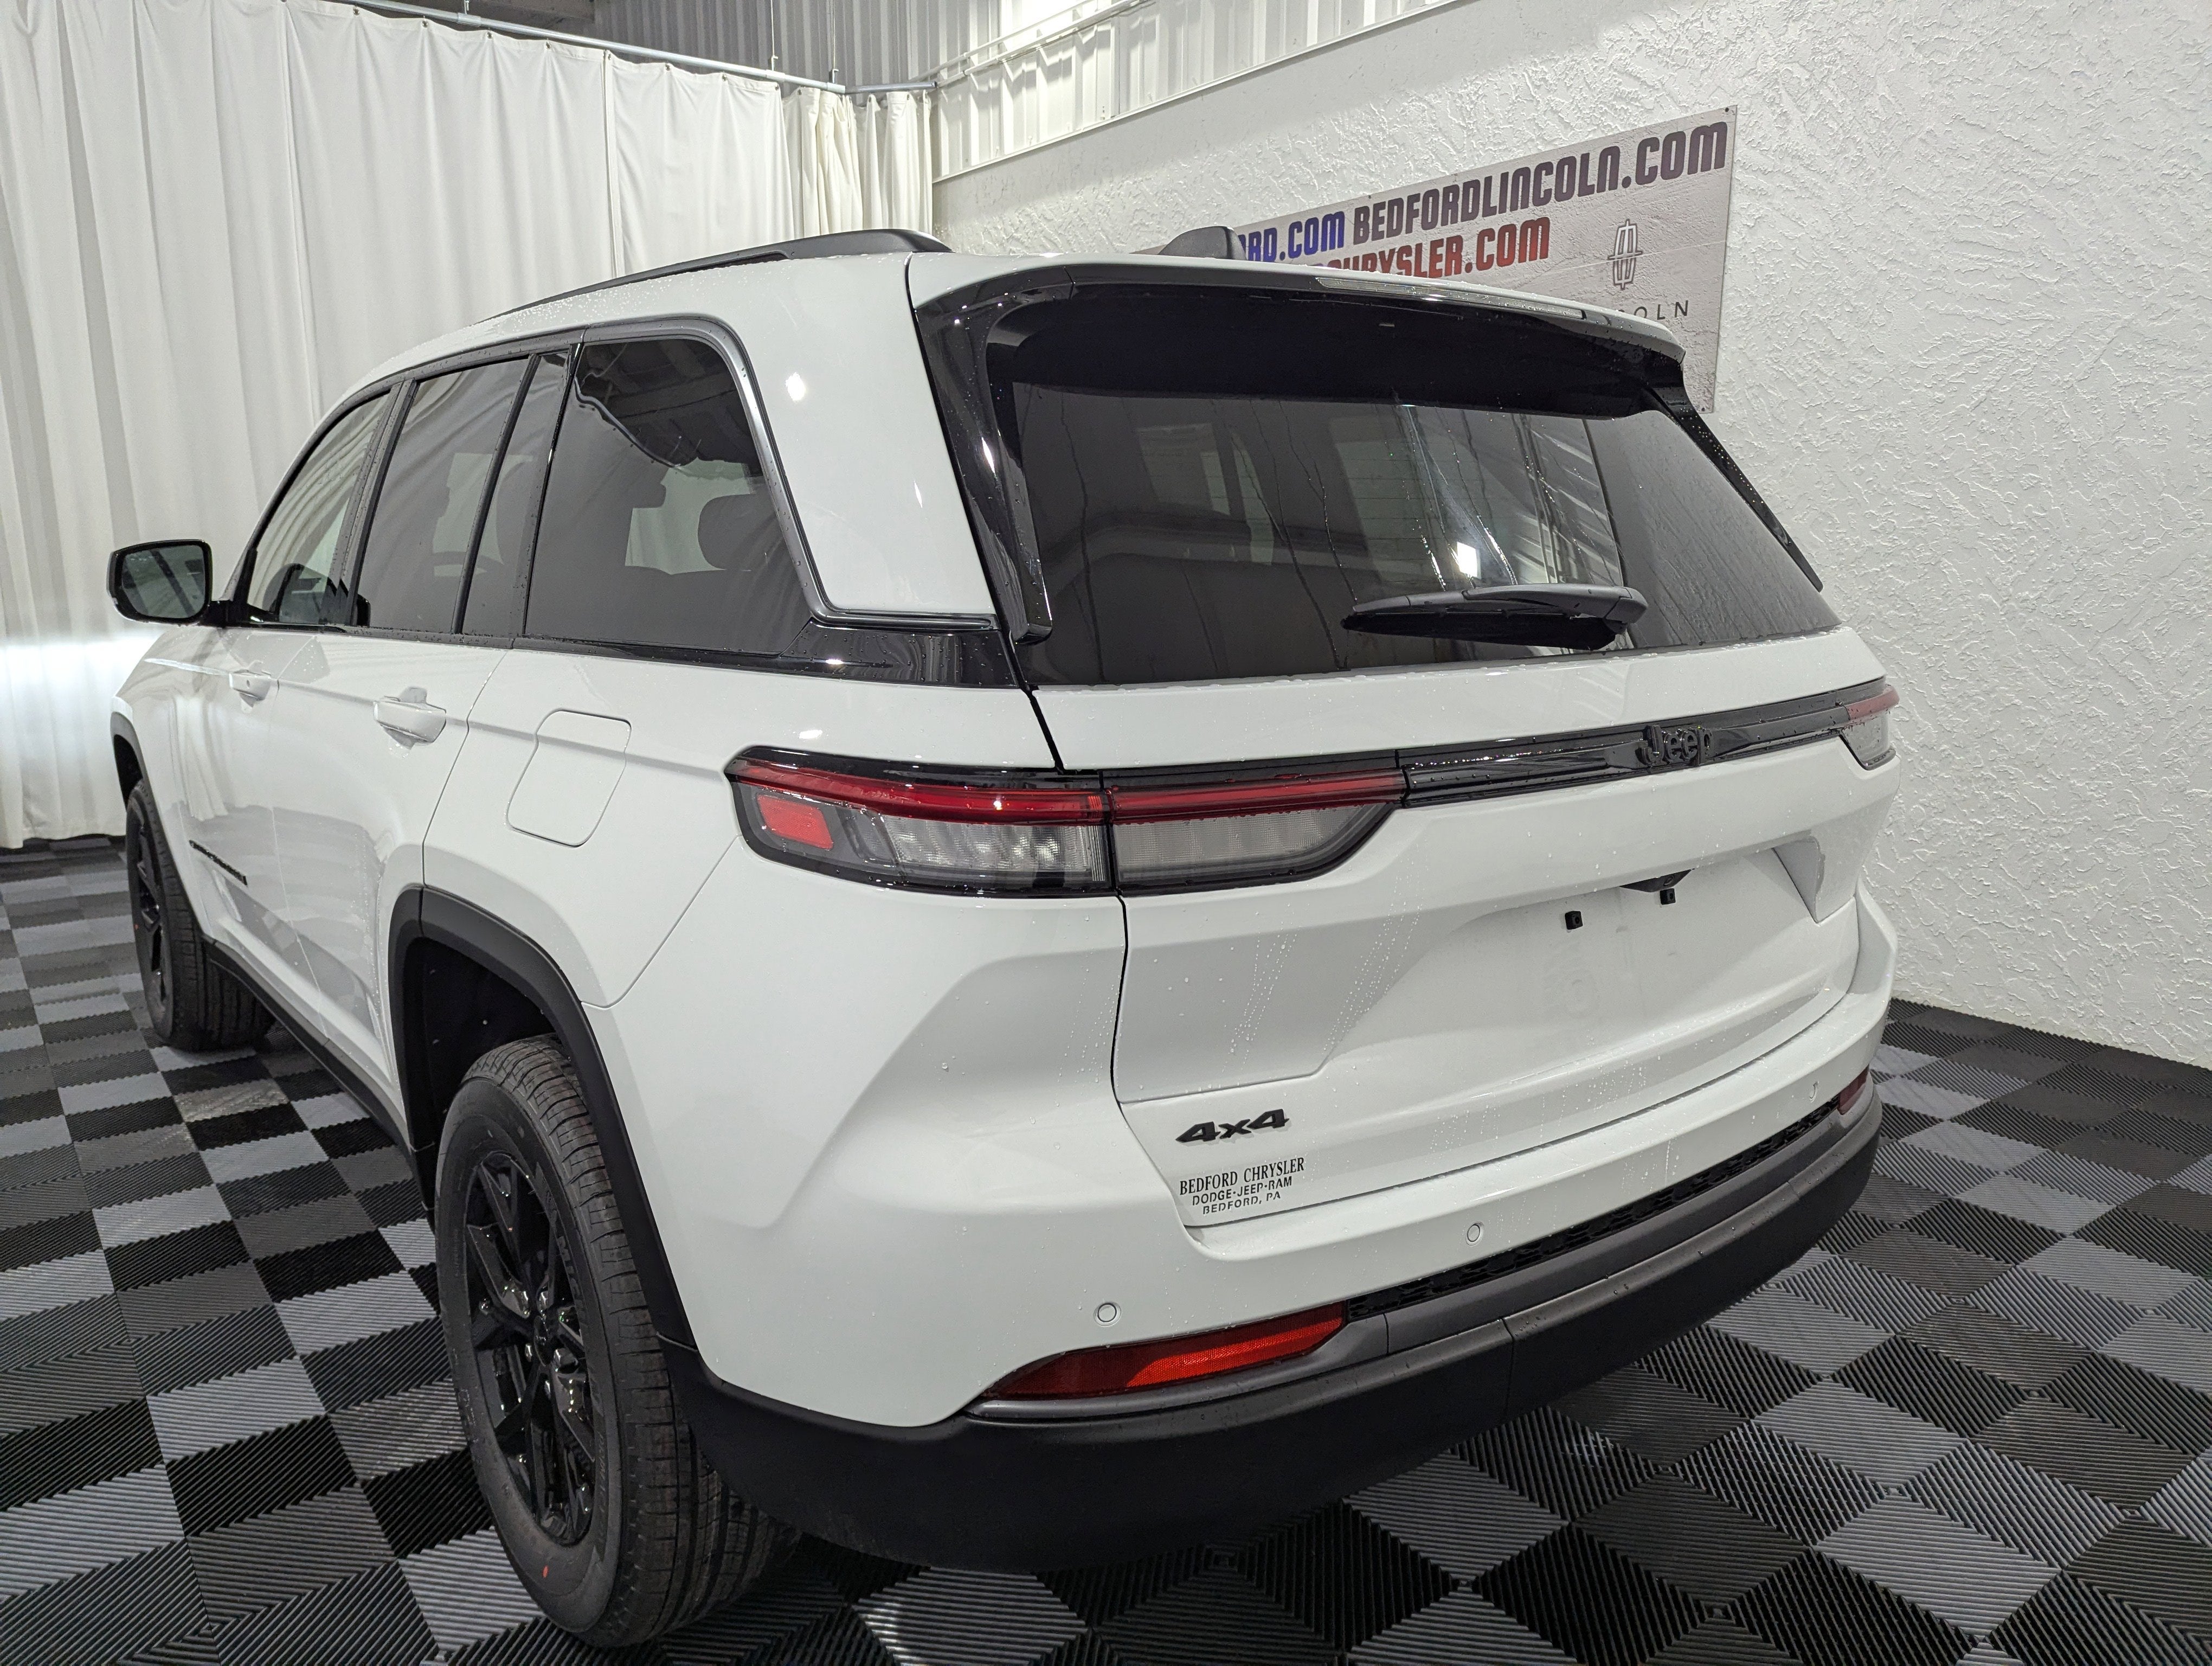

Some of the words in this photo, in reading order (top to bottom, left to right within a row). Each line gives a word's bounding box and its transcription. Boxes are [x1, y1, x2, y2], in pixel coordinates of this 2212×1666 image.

[1353, 121, 1728, 245] BEDFORDLINCOLN.COM
[1618, 300, 1688, 321] OLN
[1642, 724, 1713, 765] Jeep
[1175, 1109, 1289, 1143] 4x4
[1180, 1171, 1237, 1195] BEDFORD
[1244, 1157, 1304, 1182] CHRYSLER
[1203, 1196, 1262, 1214] BEDFORD,
[1266, 1191, 1281, 1202] PA
